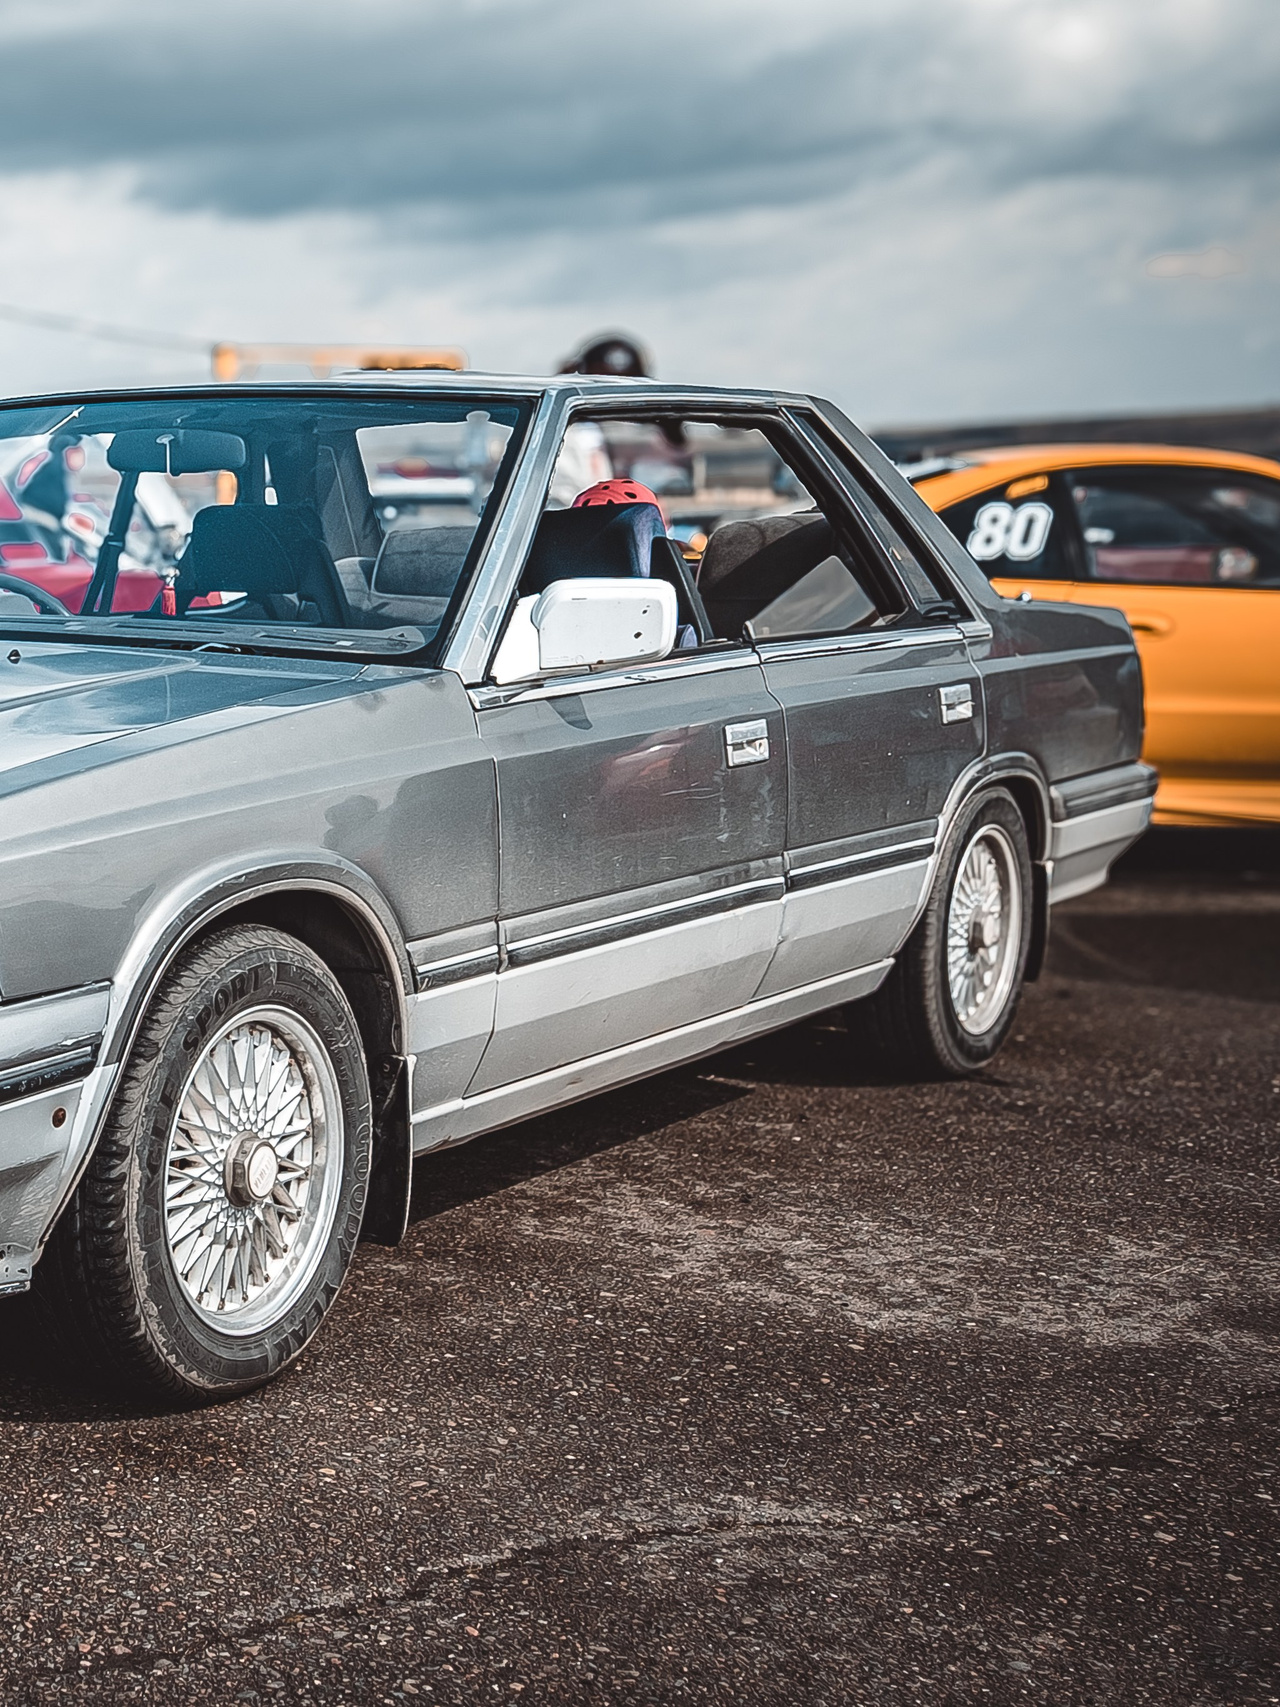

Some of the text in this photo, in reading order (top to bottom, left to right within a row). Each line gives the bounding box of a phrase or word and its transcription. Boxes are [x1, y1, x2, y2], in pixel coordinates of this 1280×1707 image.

[966, 502, 1054, 561] 80
[141, 962, 266, 1247] EAGLE SPORT
[273, 1280, 340, 1367] YEAR
